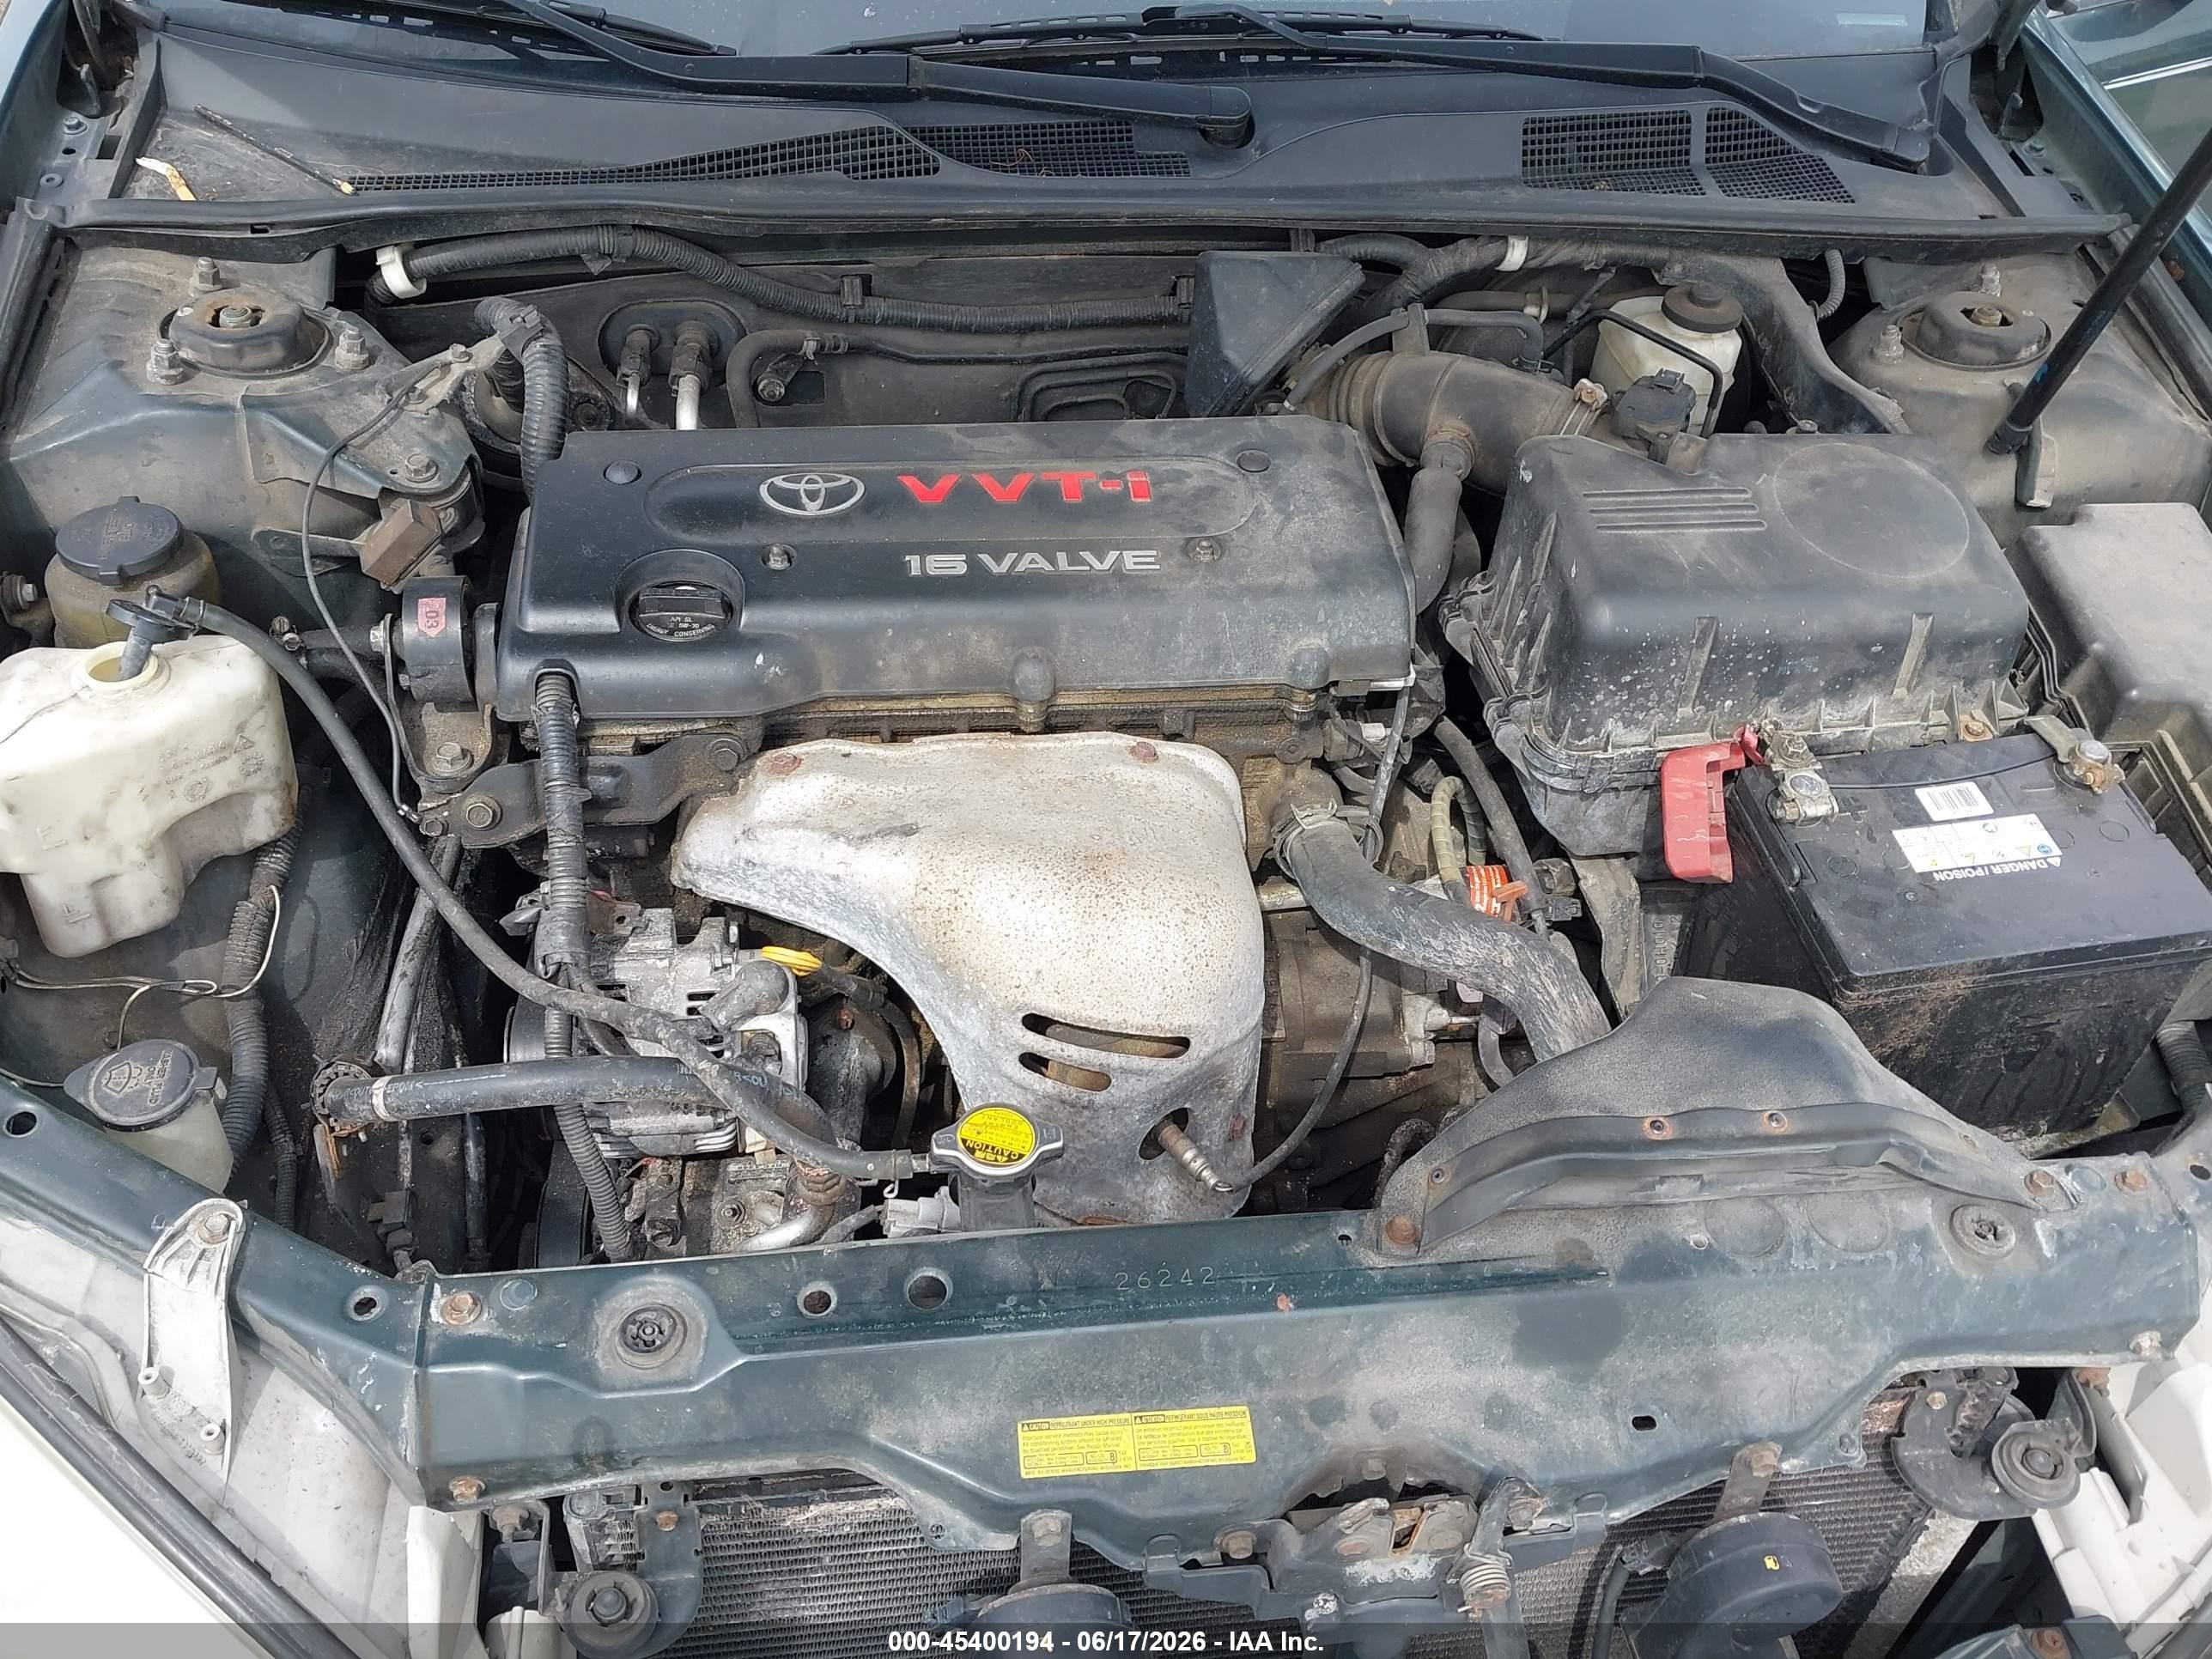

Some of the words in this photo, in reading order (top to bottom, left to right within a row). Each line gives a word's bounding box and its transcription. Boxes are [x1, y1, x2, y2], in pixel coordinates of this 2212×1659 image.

[896, 471, 1152, 502] VVT-i
[904, 553, 968, 575] 16
[976, 550, 1161, 574] VALVE
[1933, 866, 1985, 882] POISON
[1989, 859, 2049, 874] DANGER
[965, 1139, 1019, 1159] CAUTION
[1114, 1266, 1216, 1291] 26242
